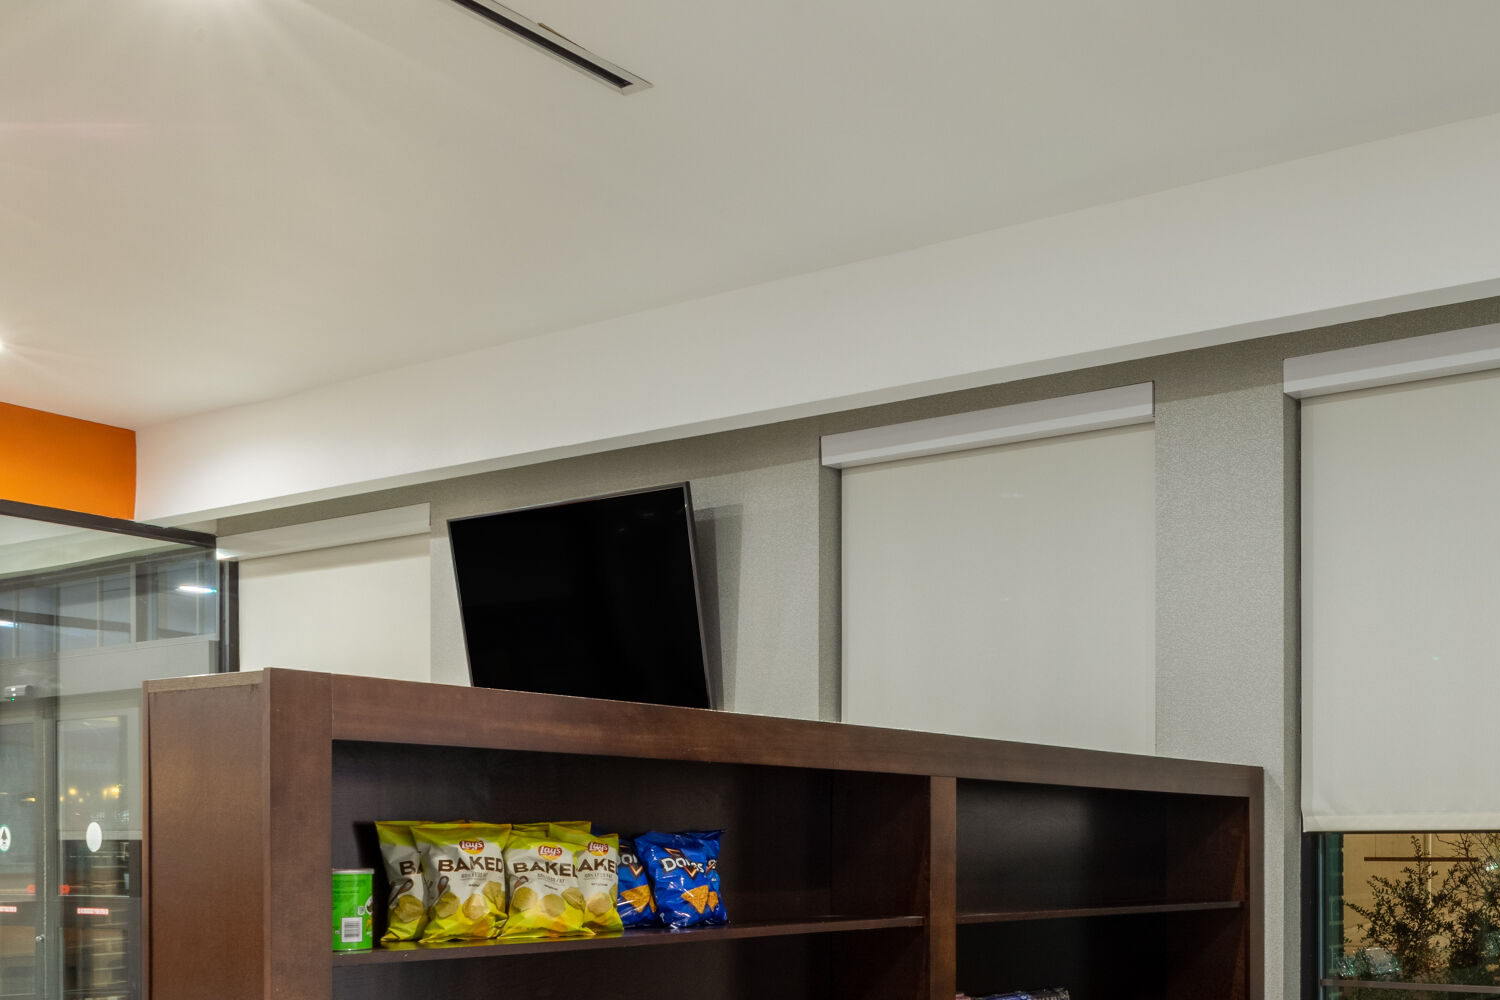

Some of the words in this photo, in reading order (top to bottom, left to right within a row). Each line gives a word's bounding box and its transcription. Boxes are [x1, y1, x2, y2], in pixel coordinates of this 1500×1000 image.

[461, 840, 484, 851] Lay's
[540, 845, 561, 857] Lay's
[589, 841, 608, 853] Lay's
[438, 856, 504, 873] BAKED
[578, 858, 617, 874] AKE
